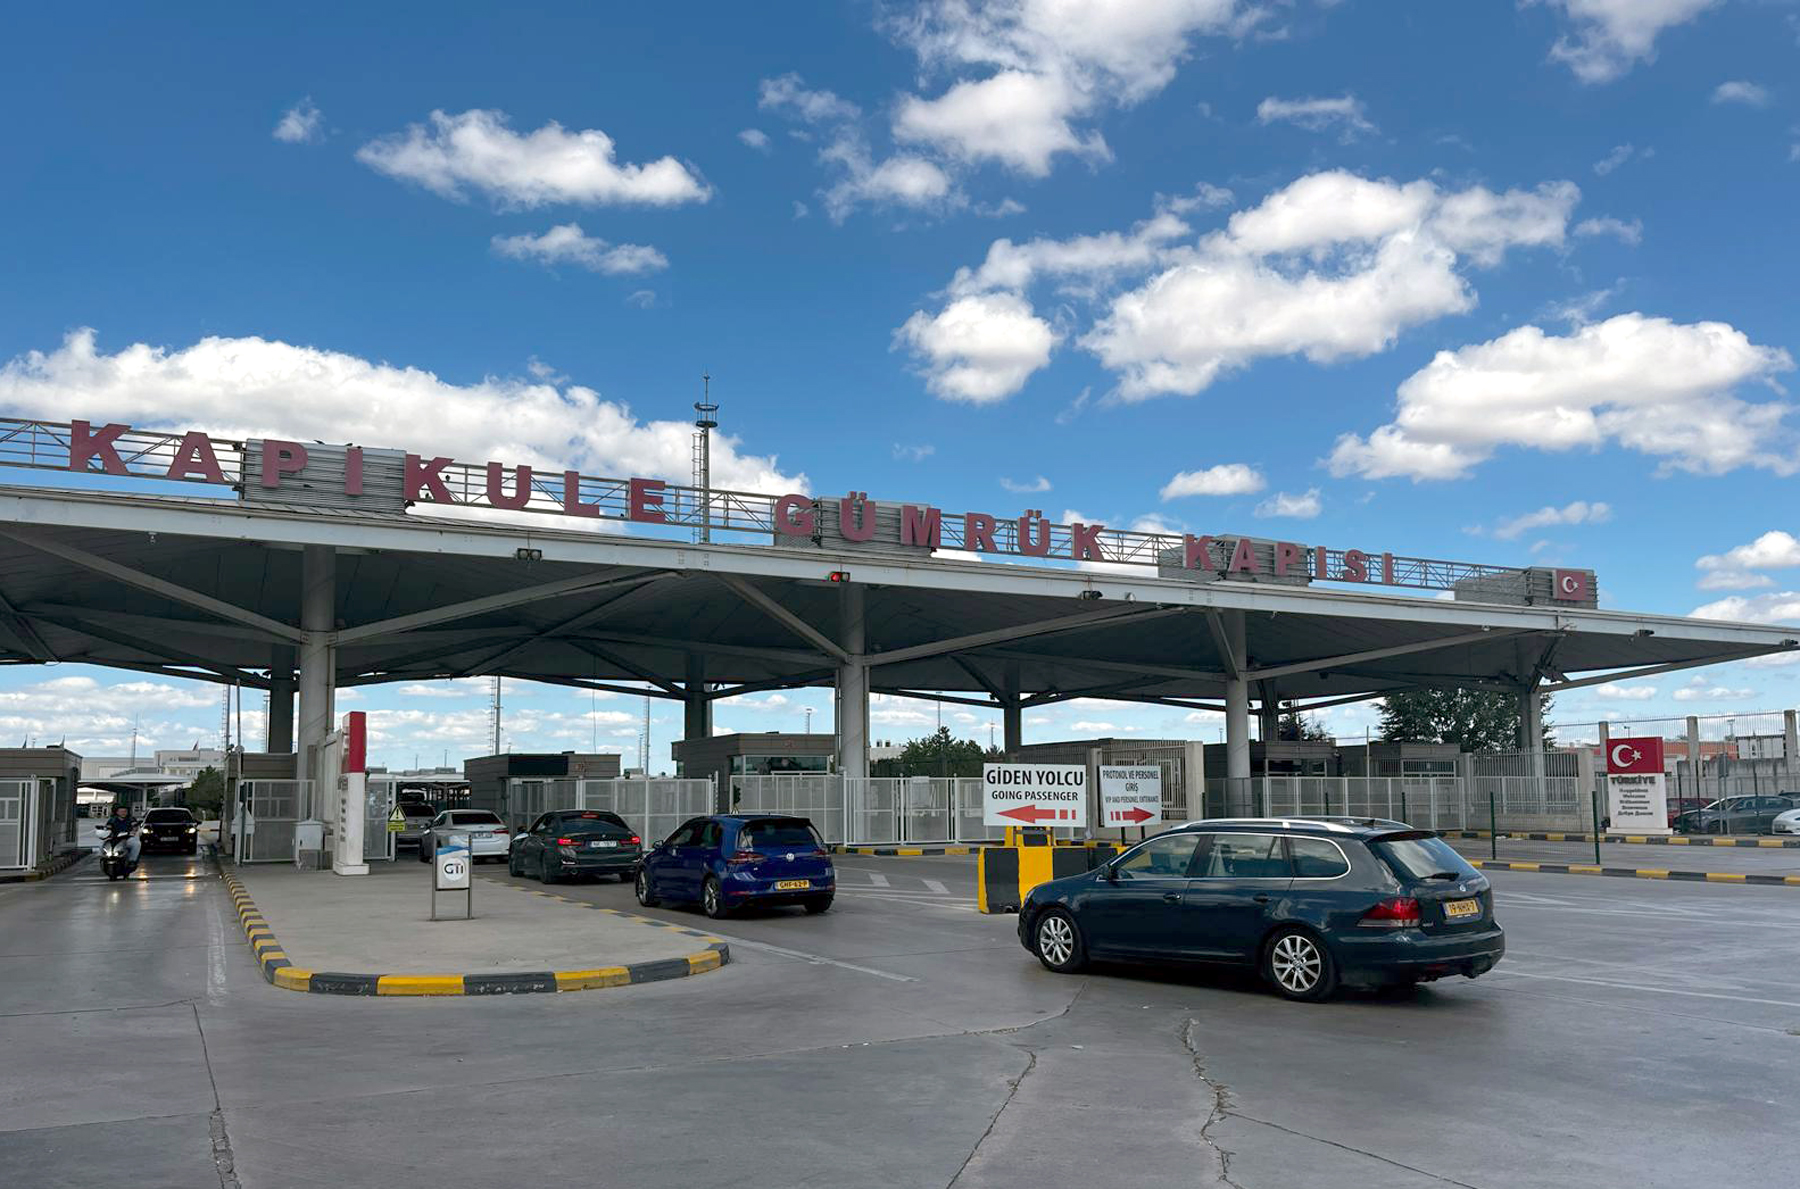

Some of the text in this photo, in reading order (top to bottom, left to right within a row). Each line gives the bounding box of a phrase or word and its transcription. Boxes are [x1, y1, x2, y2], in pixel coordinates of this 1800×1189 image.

[69, 419, 1394, 586] KAPIKULE GÜMRÜK KAPISI
[986, 766, 1084, 786] GİDEN YOLCU
[1102, 770, 1159, 780] PROTOKOL VE PERSONEL
[1610, 774, 1656, 785] TÜRKİYE
[991, 790, 1079, 801] GOING PASSENGER
[444, 863, 464, 874] GTI
